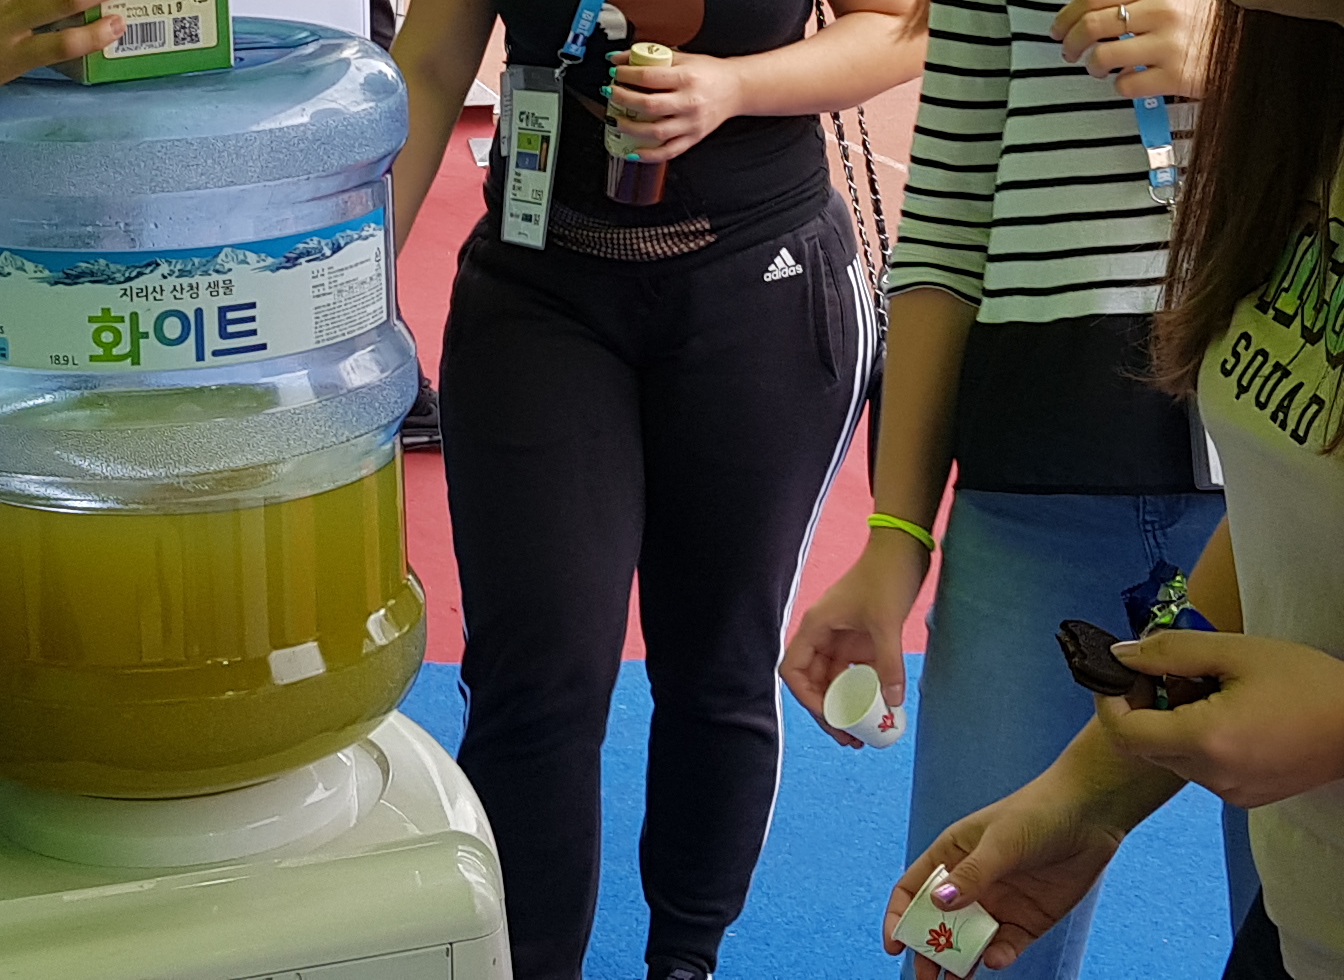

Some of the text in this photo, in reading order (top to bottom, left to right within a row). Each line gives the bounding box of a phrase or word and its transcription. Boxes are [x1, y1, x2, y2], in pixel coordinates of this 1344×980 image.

[119, 278, 235, 303] 지리산 산청 샘물
[763, 263, 804, 283] adidas
[87, 301, 268, 366] 화이트
[1220, 331, 1326, 446] SQUAD
